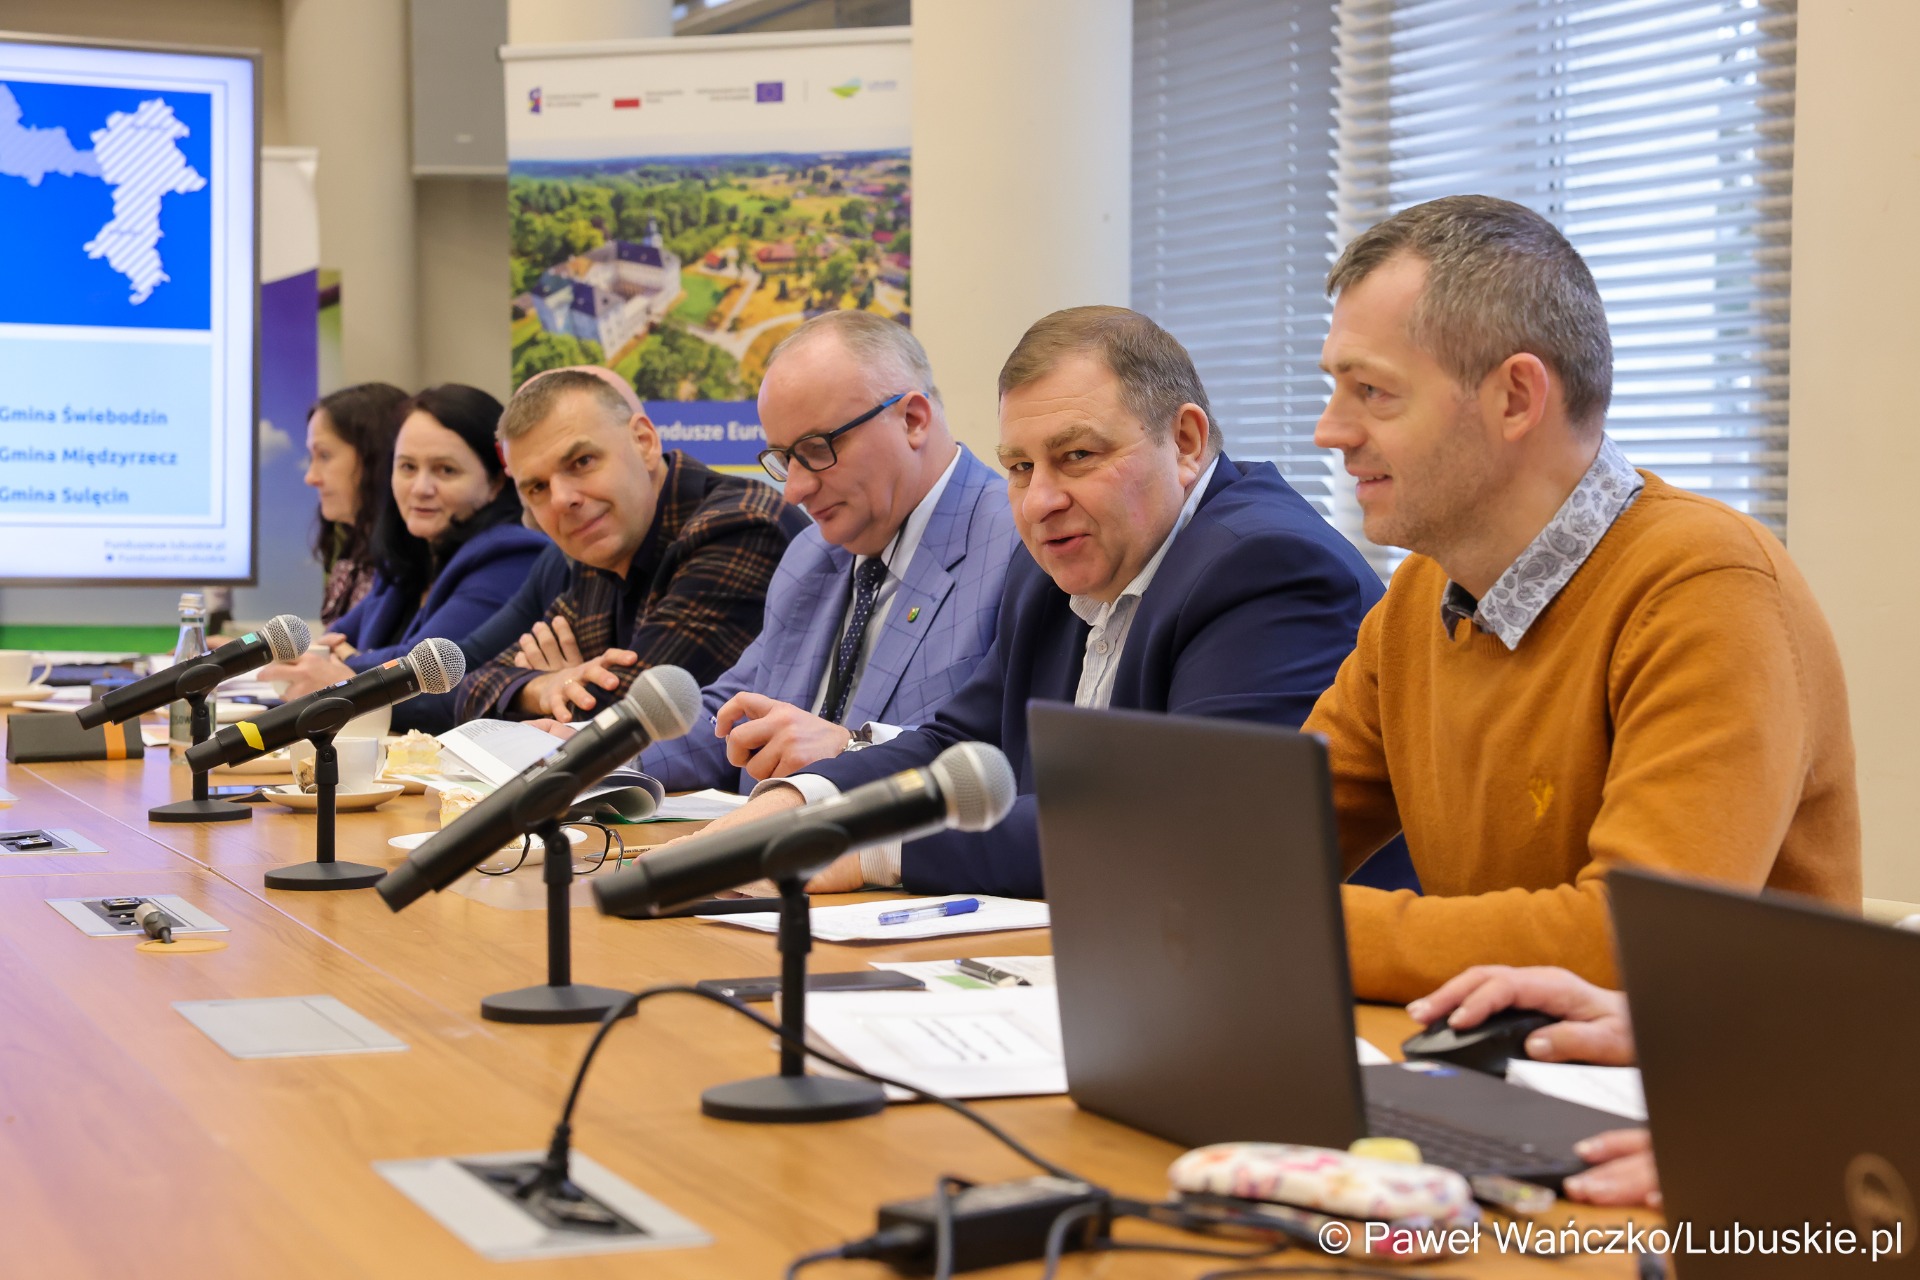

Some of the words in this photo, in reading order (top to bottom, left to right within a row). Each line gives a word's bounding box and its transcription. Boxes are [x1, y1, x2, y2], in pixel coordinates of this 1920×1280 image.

[0, 405, 56, 423] Gmina
[62, 404, 168, 425] Świebodzin
[656, 420, 724, 441] ndusze
[0, 445, 56, 463] Gmina
[62, 446, 178, 466] Międzyrzecz
[0, 485, 56, 503] Gmina
[62, 487, 129, 506] Sulęcin
